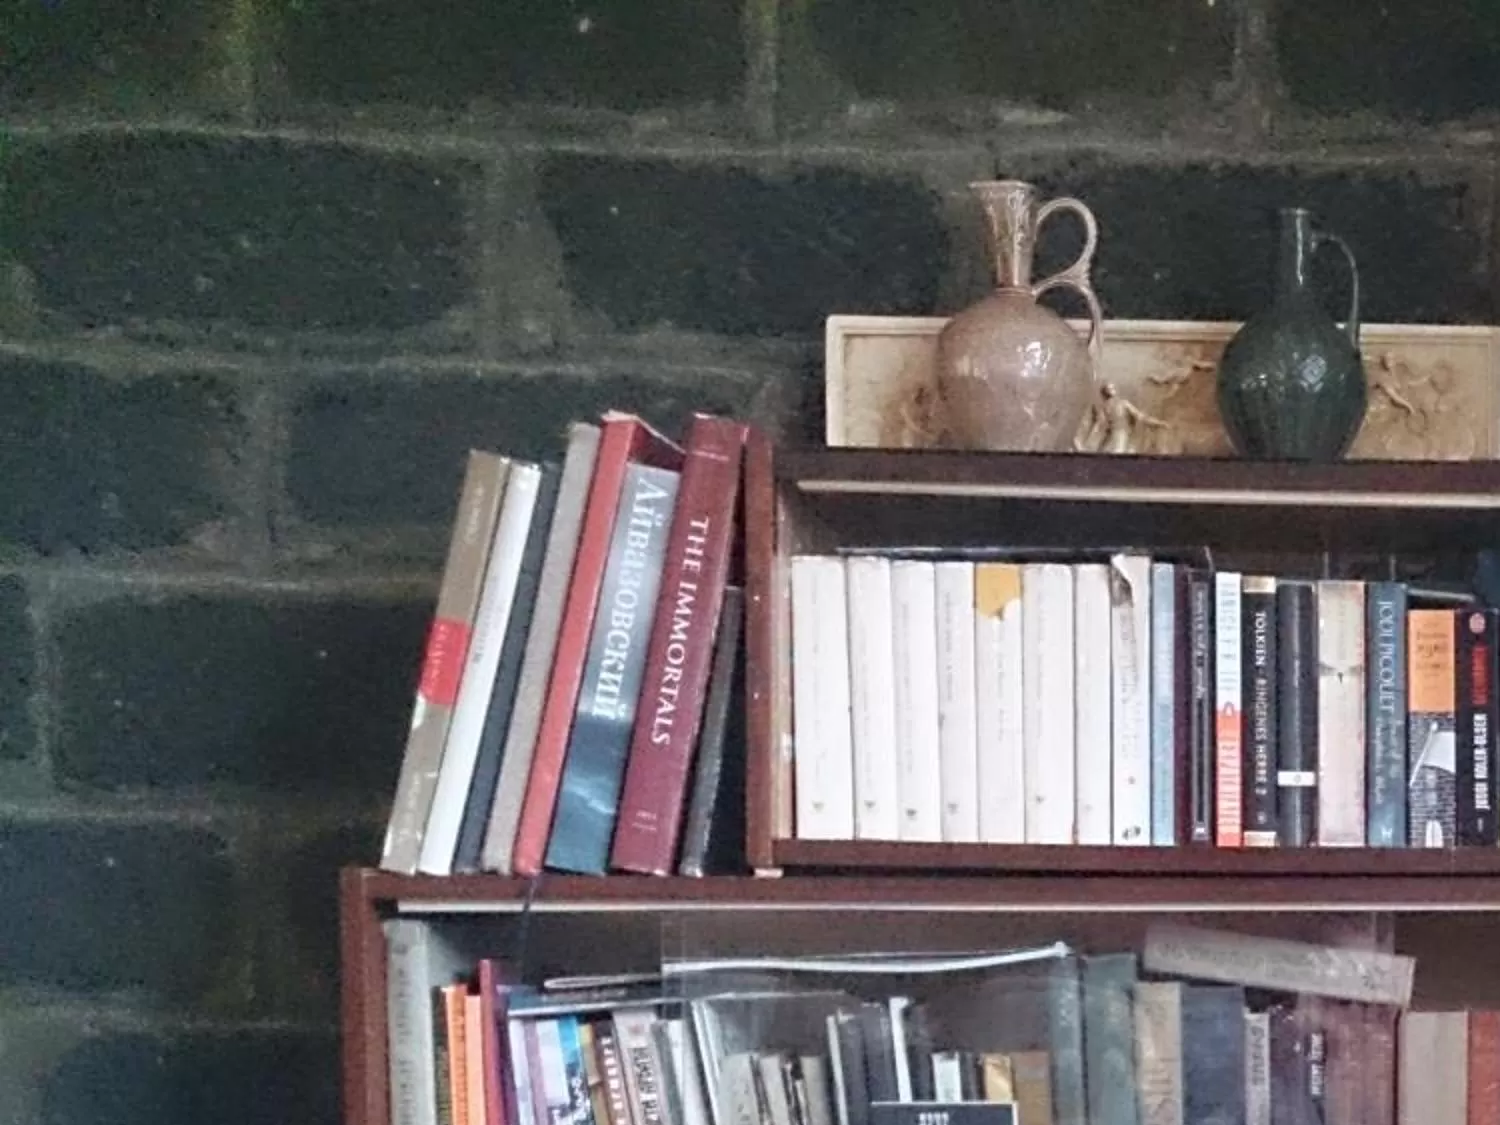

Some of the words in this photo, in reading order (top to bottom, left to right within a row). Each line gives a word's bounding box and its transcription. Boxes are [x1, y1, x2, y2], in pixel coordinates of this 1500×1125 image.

[682, 516, 709, 573] THE
[1254, 610, 1268, 667] TOLKIEN
[1377, 600, 1395, 640] JODI
[651, 583, 698, 745] IMMORTALS
[1377, 642, 1395, 712] PICOULT
[1254, 677, 1268, 742] RINGENES
[1254, 745, 1268, 784] HERRE
